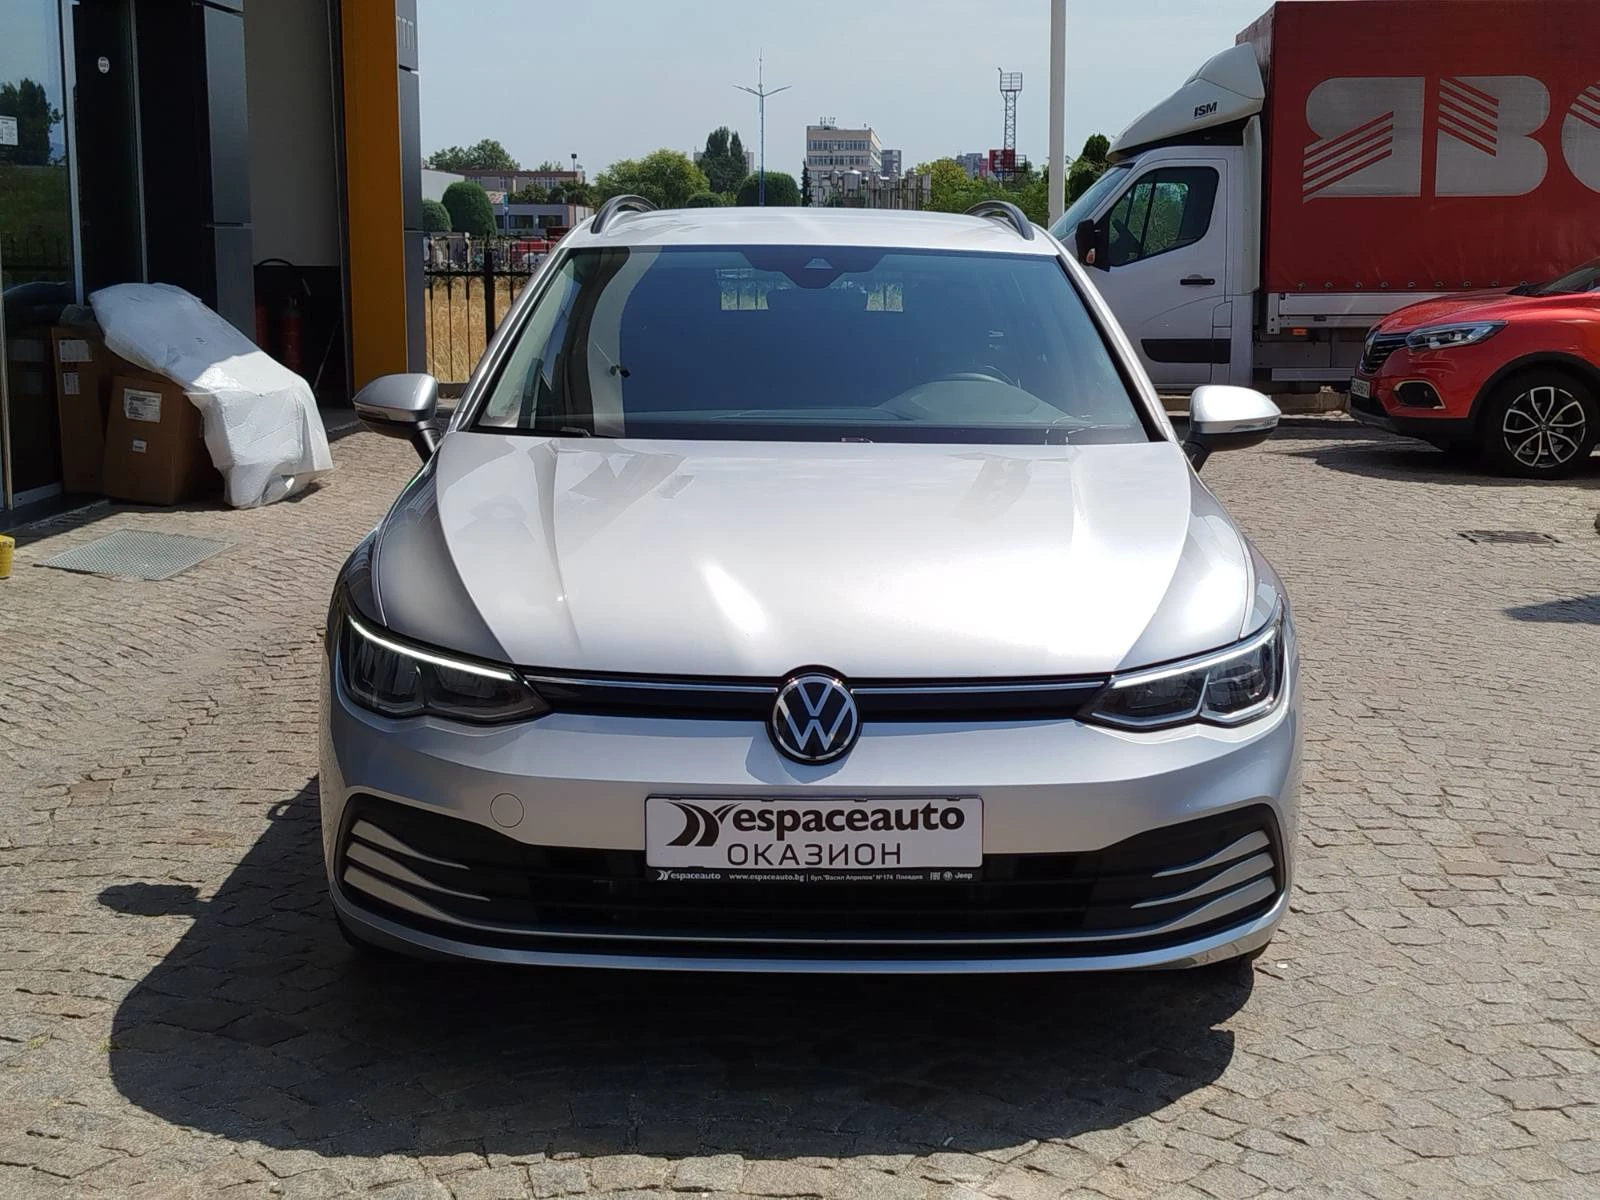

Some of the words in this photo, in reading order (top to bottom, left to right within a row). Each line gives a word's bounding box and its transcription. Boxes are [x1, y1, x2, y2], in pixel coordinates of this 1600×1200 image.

[1194, 101, 1218, 118] ISM
[733, 802, 965, 841] espaceauto
[728, 843, 901, 866] ОКАЗИОН
[671, 872, 721, 881] espaceauto
[729, 873, 805, 882] www.espaceauto.bg
[955, 872, 973, 880] Jeep
